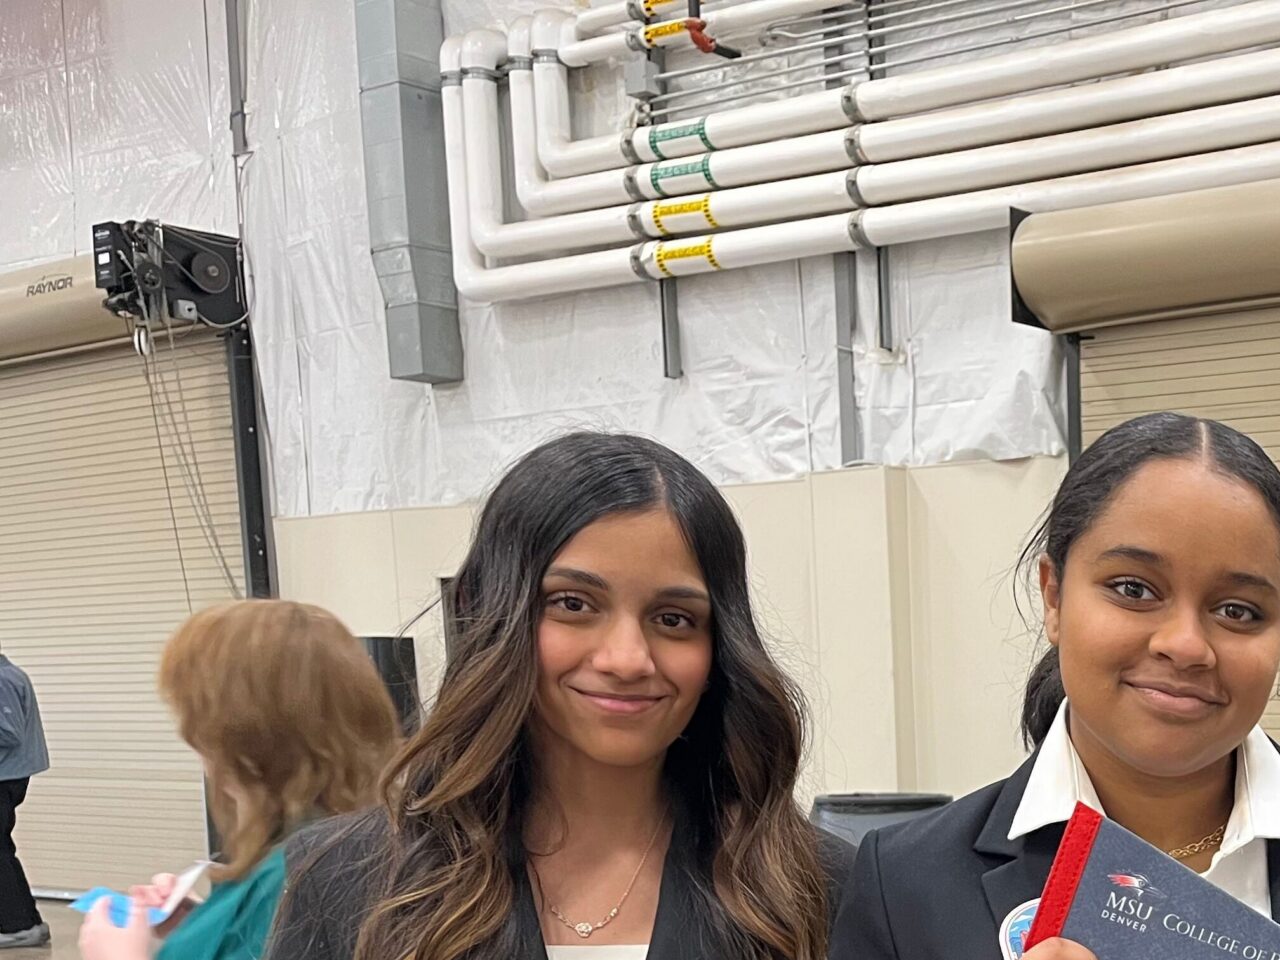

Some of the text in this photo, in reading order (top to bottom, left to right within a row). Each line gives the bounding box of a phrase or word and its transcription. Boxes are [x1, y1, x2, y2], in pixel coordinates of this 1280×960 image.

[26, 277, 73, 297] RAYNOR
[1106, 891, 1153, 921] MSU
[1101, 909, 1147, 933] DENVER
[1163, 913, 1241, 955] COLLEGE
